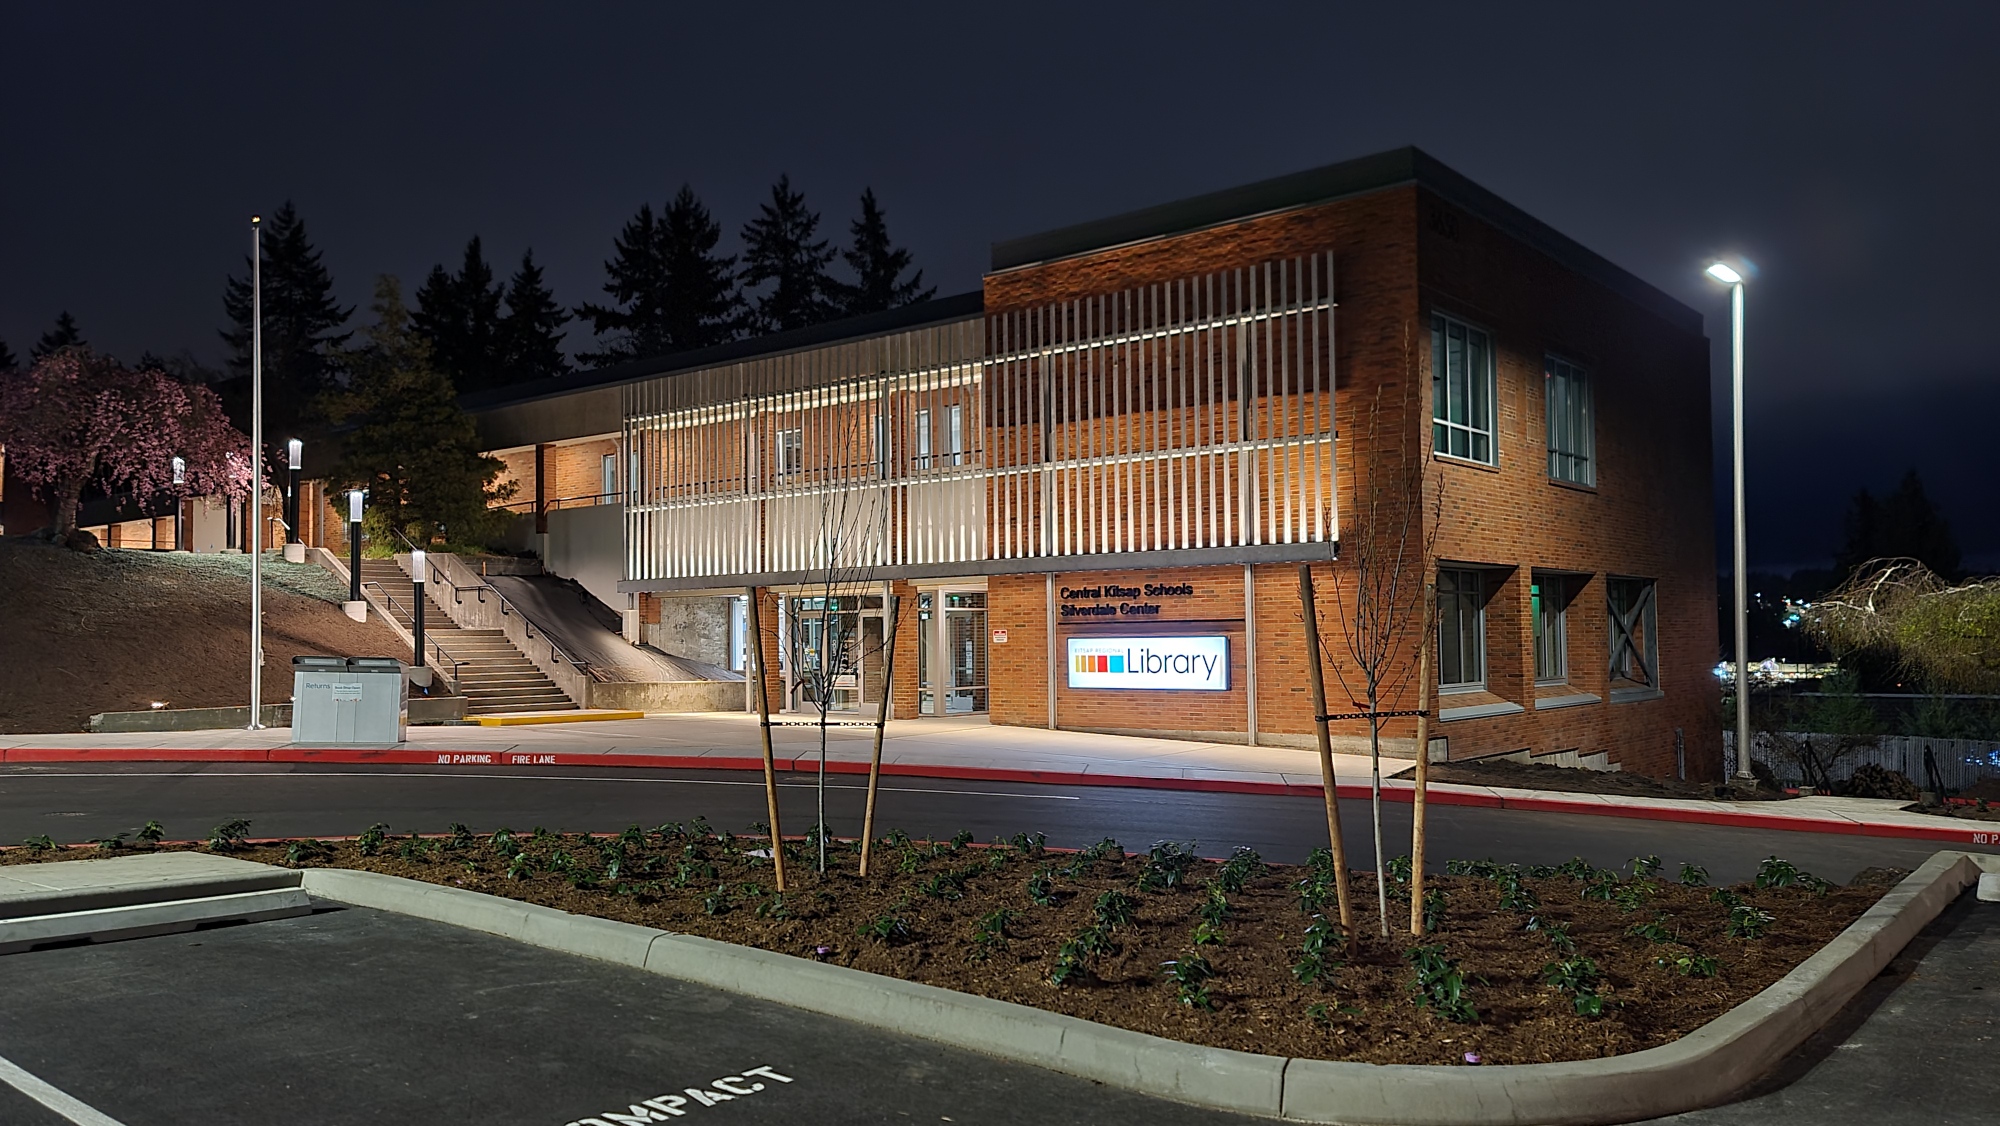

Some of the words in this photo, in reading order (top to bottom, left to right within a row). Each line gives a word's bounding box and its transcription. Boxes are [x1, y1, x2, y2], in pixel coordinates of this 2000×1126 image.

[1060, 586, 1101, 599] Central
[1104, 584, 1141, 600] Kitsap
[1144, 583, 1193, 596] Schools
[1060, 604, 1117, 616] Silverdale
[1119, 602, 1161, 615] Center
[1127, 648, 1218, 681] Library
[438, 754, 451, 764] NO
[453, 754, 492, 764] PARKING
[512, 755, 531, 764] FIRE
[533, 755, 556, 764] LANE
[1973, 833, 1988, 844] NO
